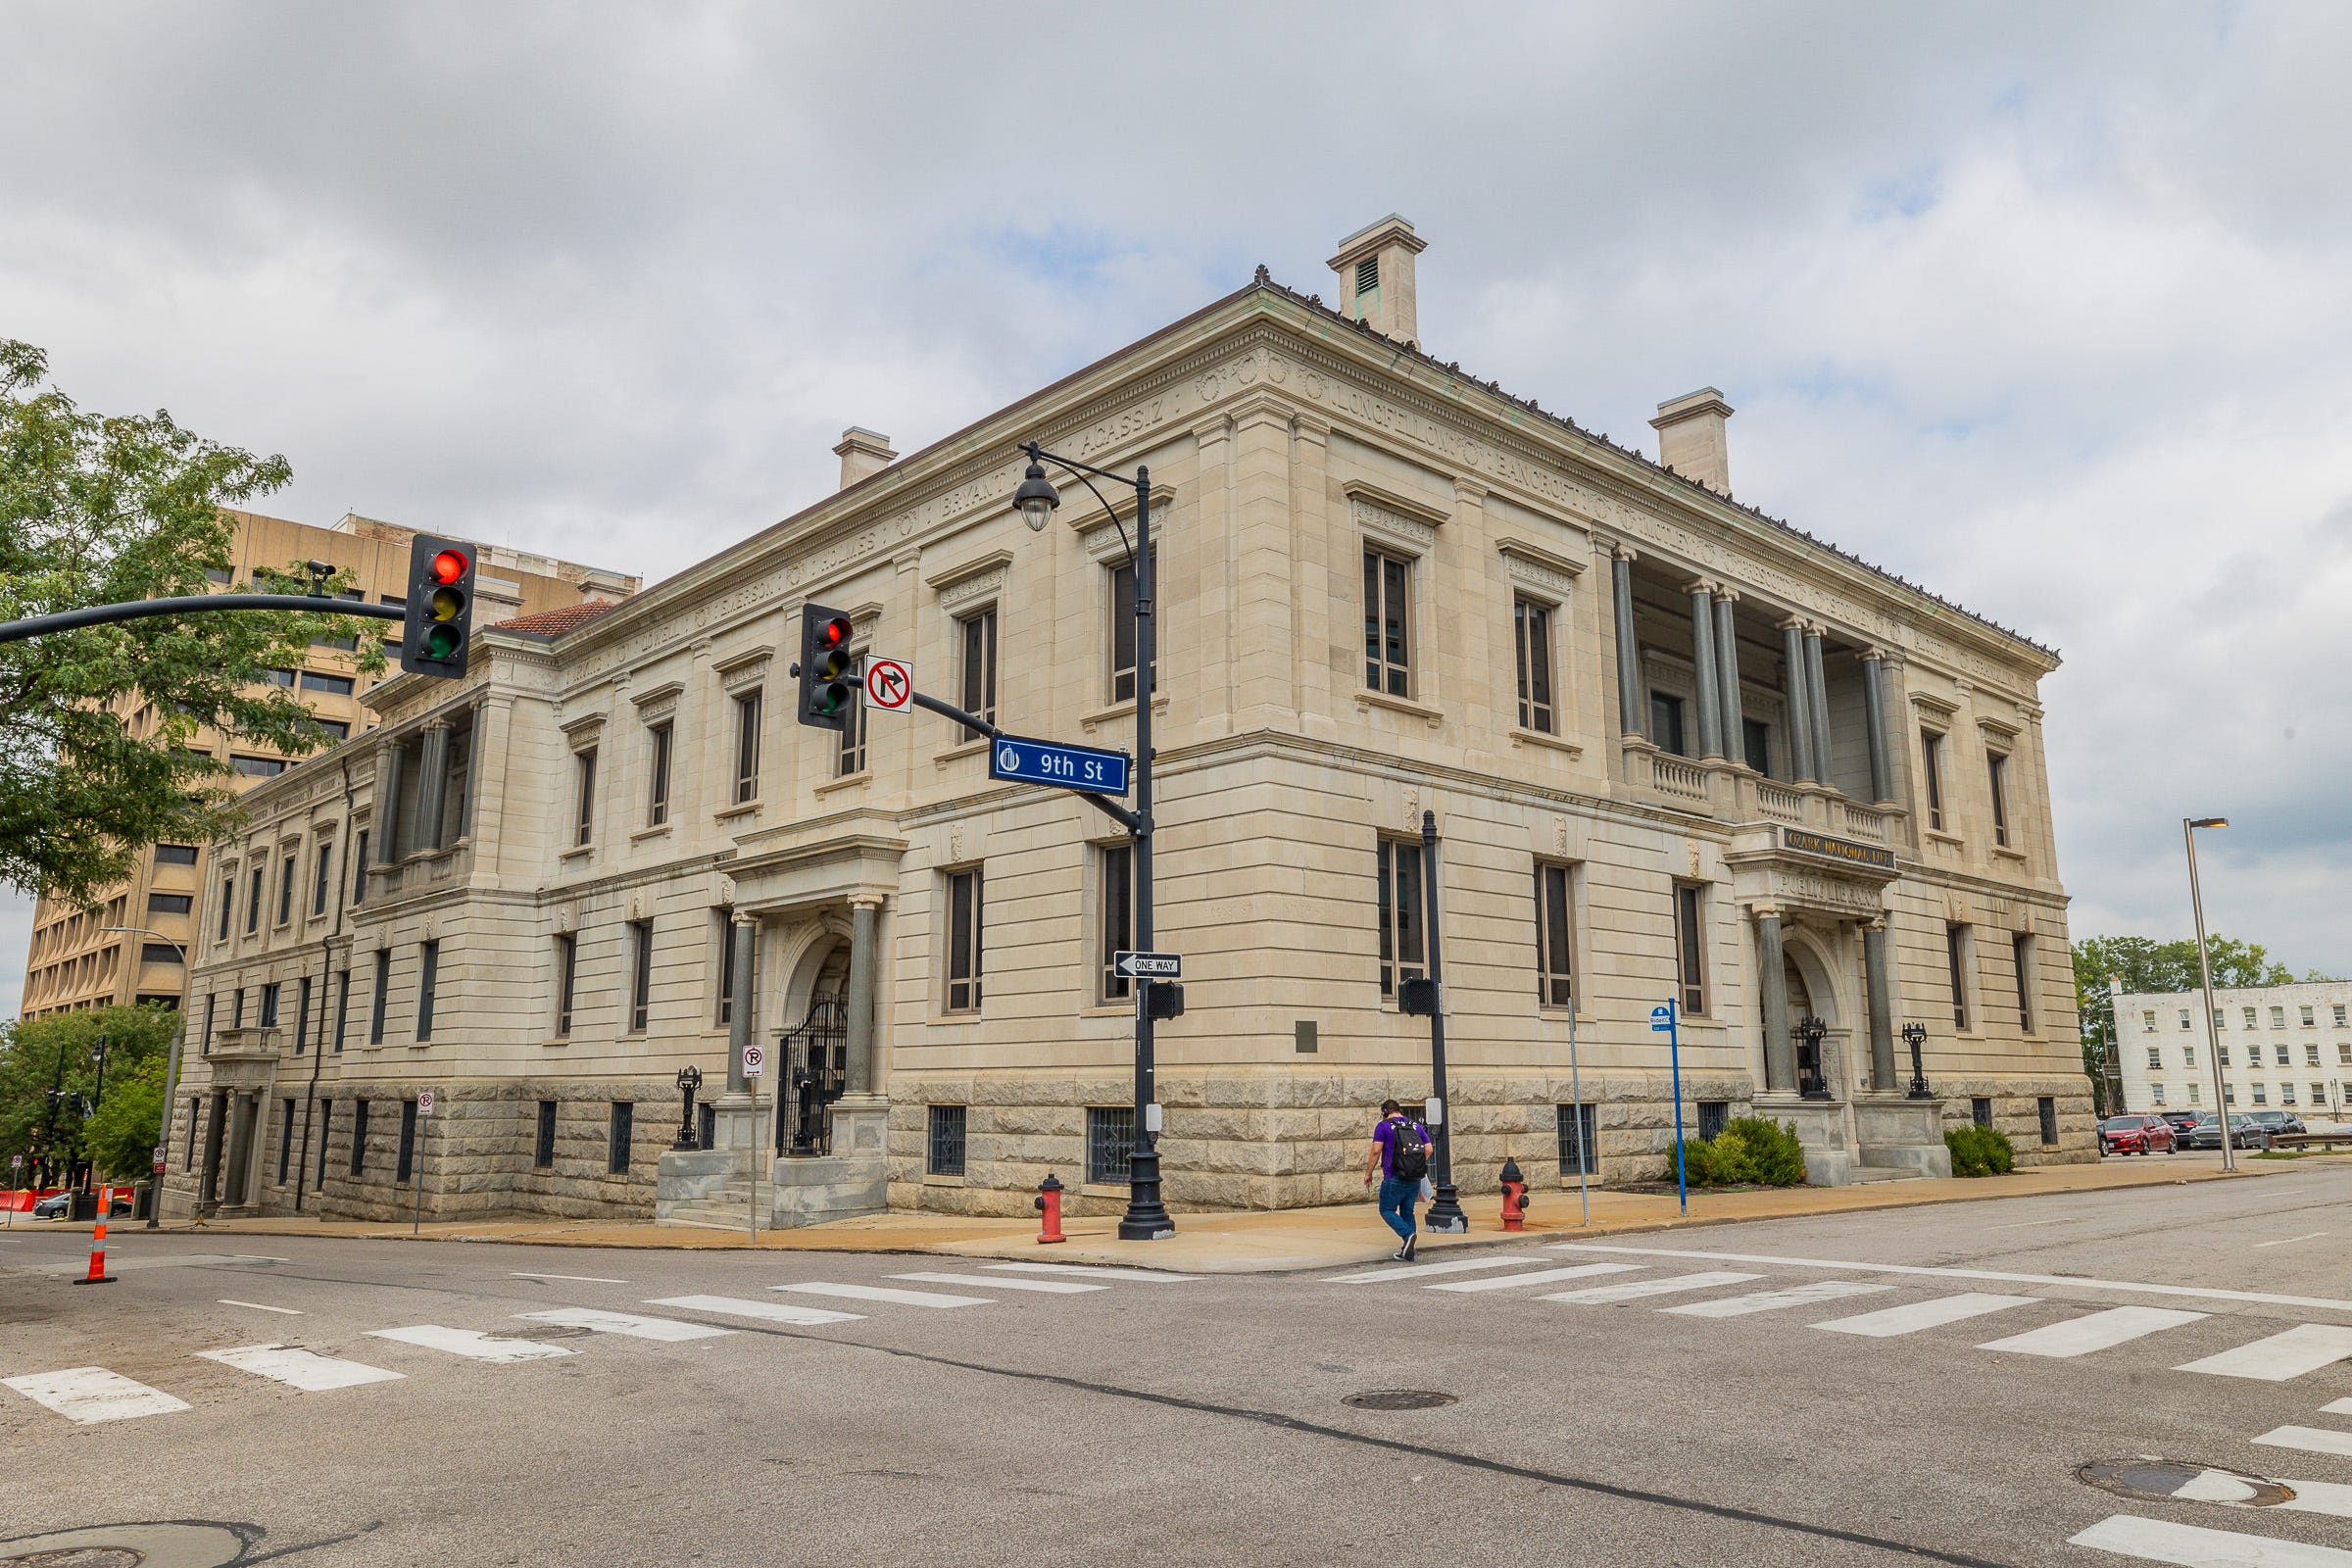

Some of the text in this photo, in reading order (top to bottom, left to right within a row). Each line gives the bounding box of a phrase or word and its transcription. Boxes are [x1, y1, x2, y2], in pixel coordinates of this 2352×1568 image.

[1495, 454, 1579, 507] BANCROFT
[1041, 754, 1103, 781] 9th St
[1788, 832, 1820, 852] OZARK
[1824, 840, 1870, 862] NATIONAL
[1781, 875, 1882, 908] PUBLIC LIBRARY
[1135, 959, 1175, 971] ONE WAY
